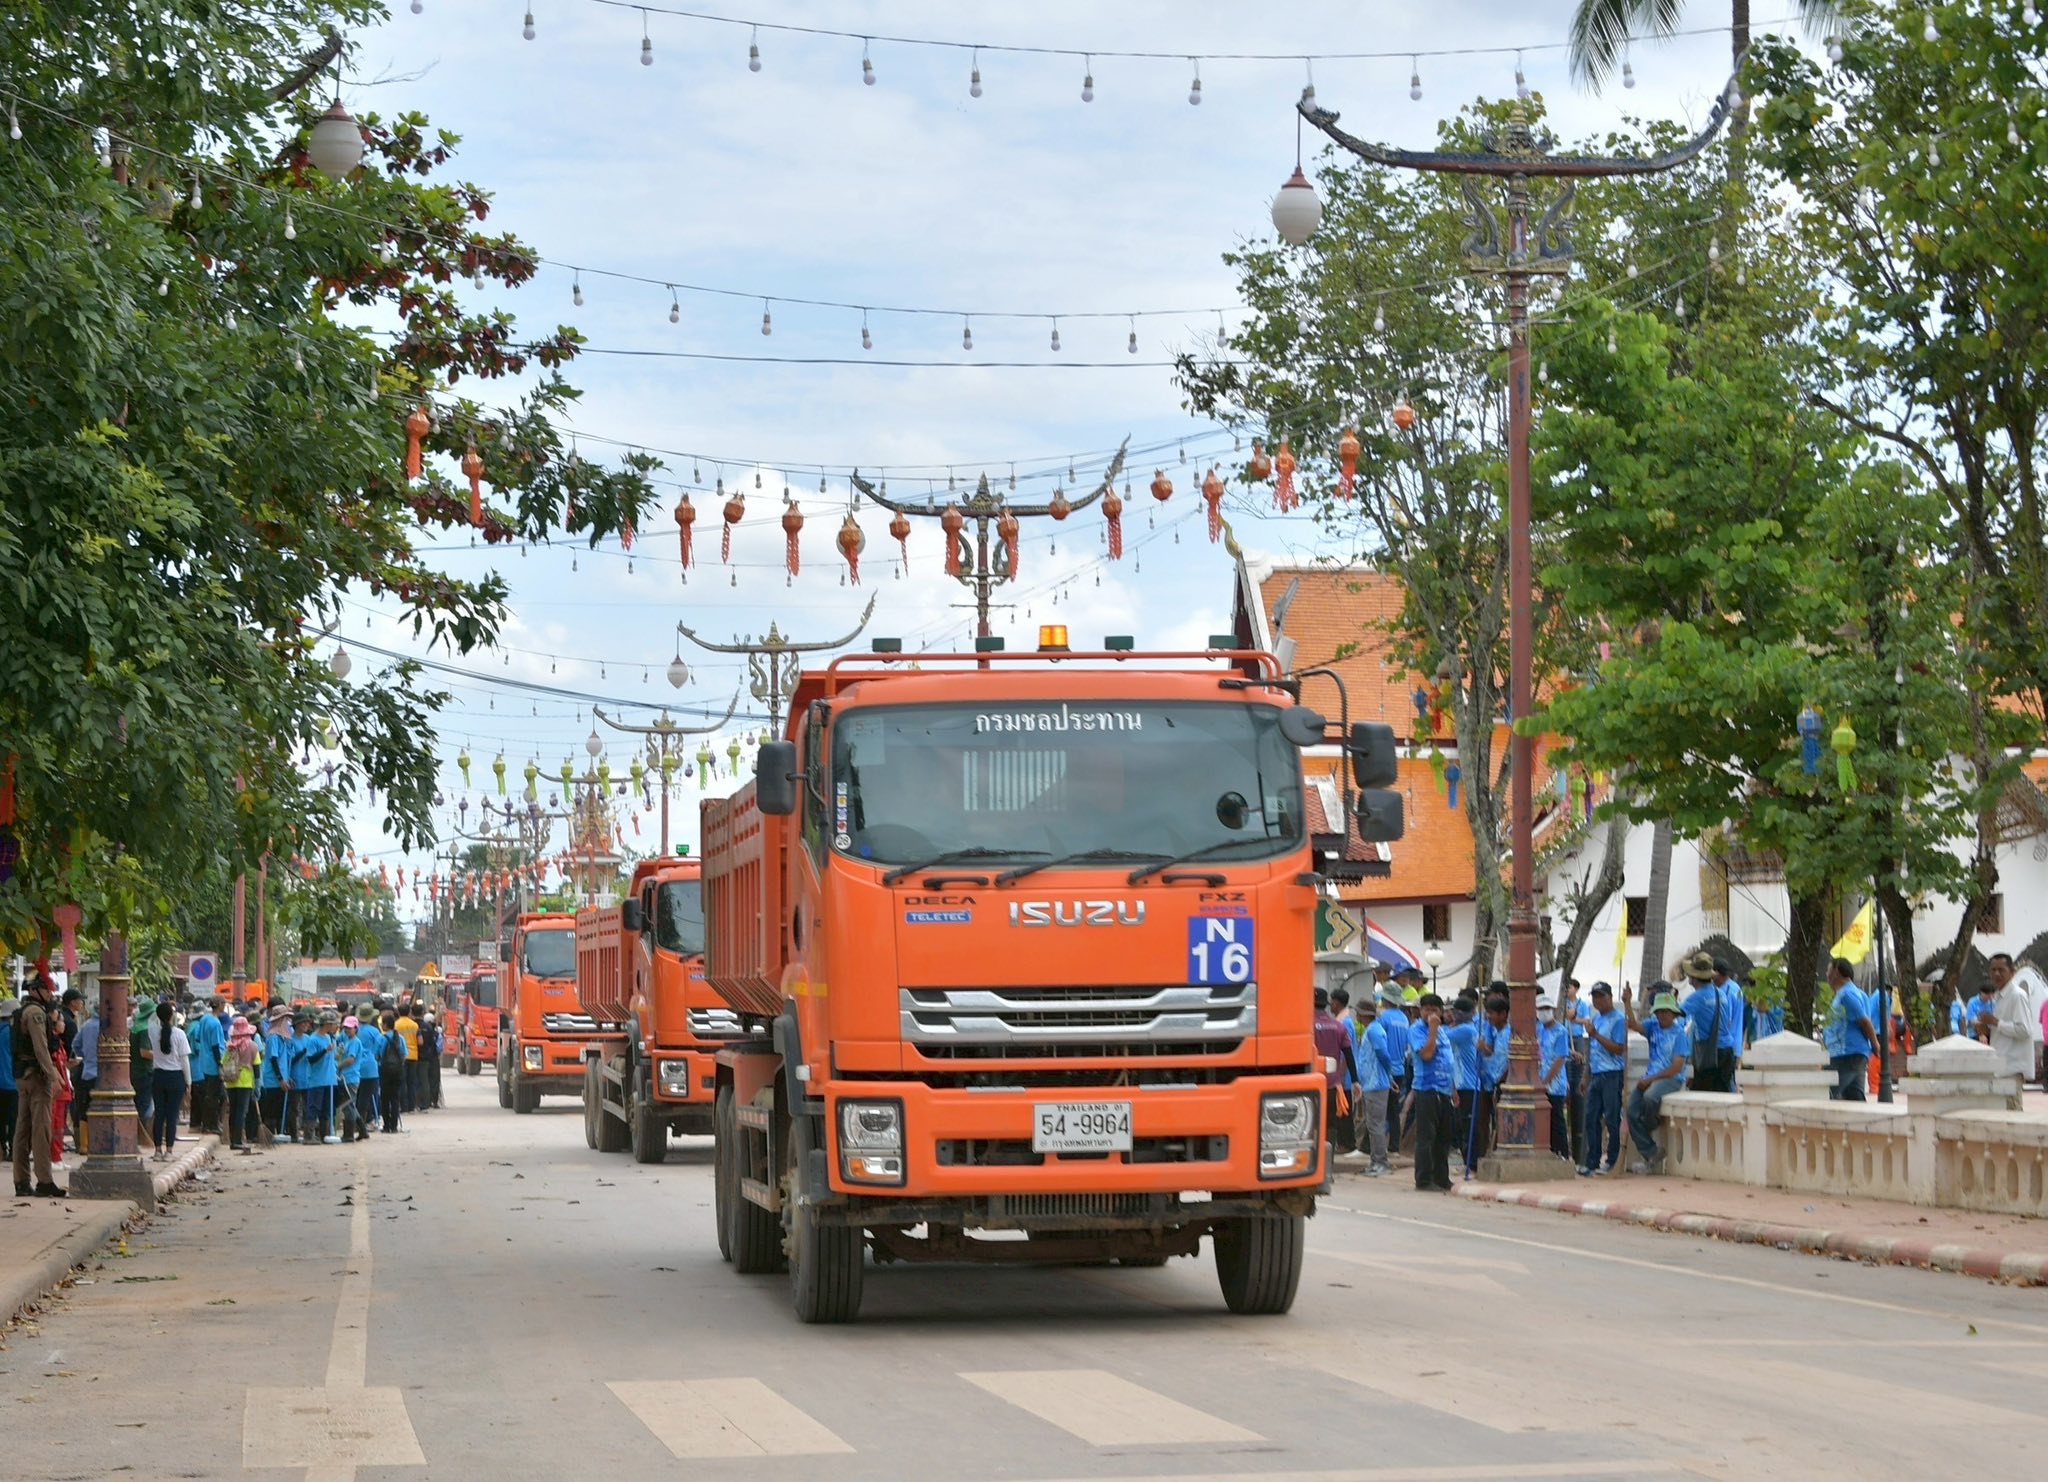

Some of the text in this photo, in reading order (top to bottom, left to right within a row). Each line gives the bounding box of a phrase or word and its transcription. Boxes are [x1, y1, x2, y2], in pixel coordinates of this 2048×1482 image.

[975, 703, 1143, 732] กรมชลประทาน
[905, 896, 976, 905] DECA
[1199, 892, 1246, 901] FXZ
[910, 912, 967, 921] TELETEC
[1009, 900, 1145, 927] ISUZU
[1206, 917, 1235, 942] N
[1191, 942, 1250, 982] 16
[1056, 1104, 1108, 1112] THAILAND
